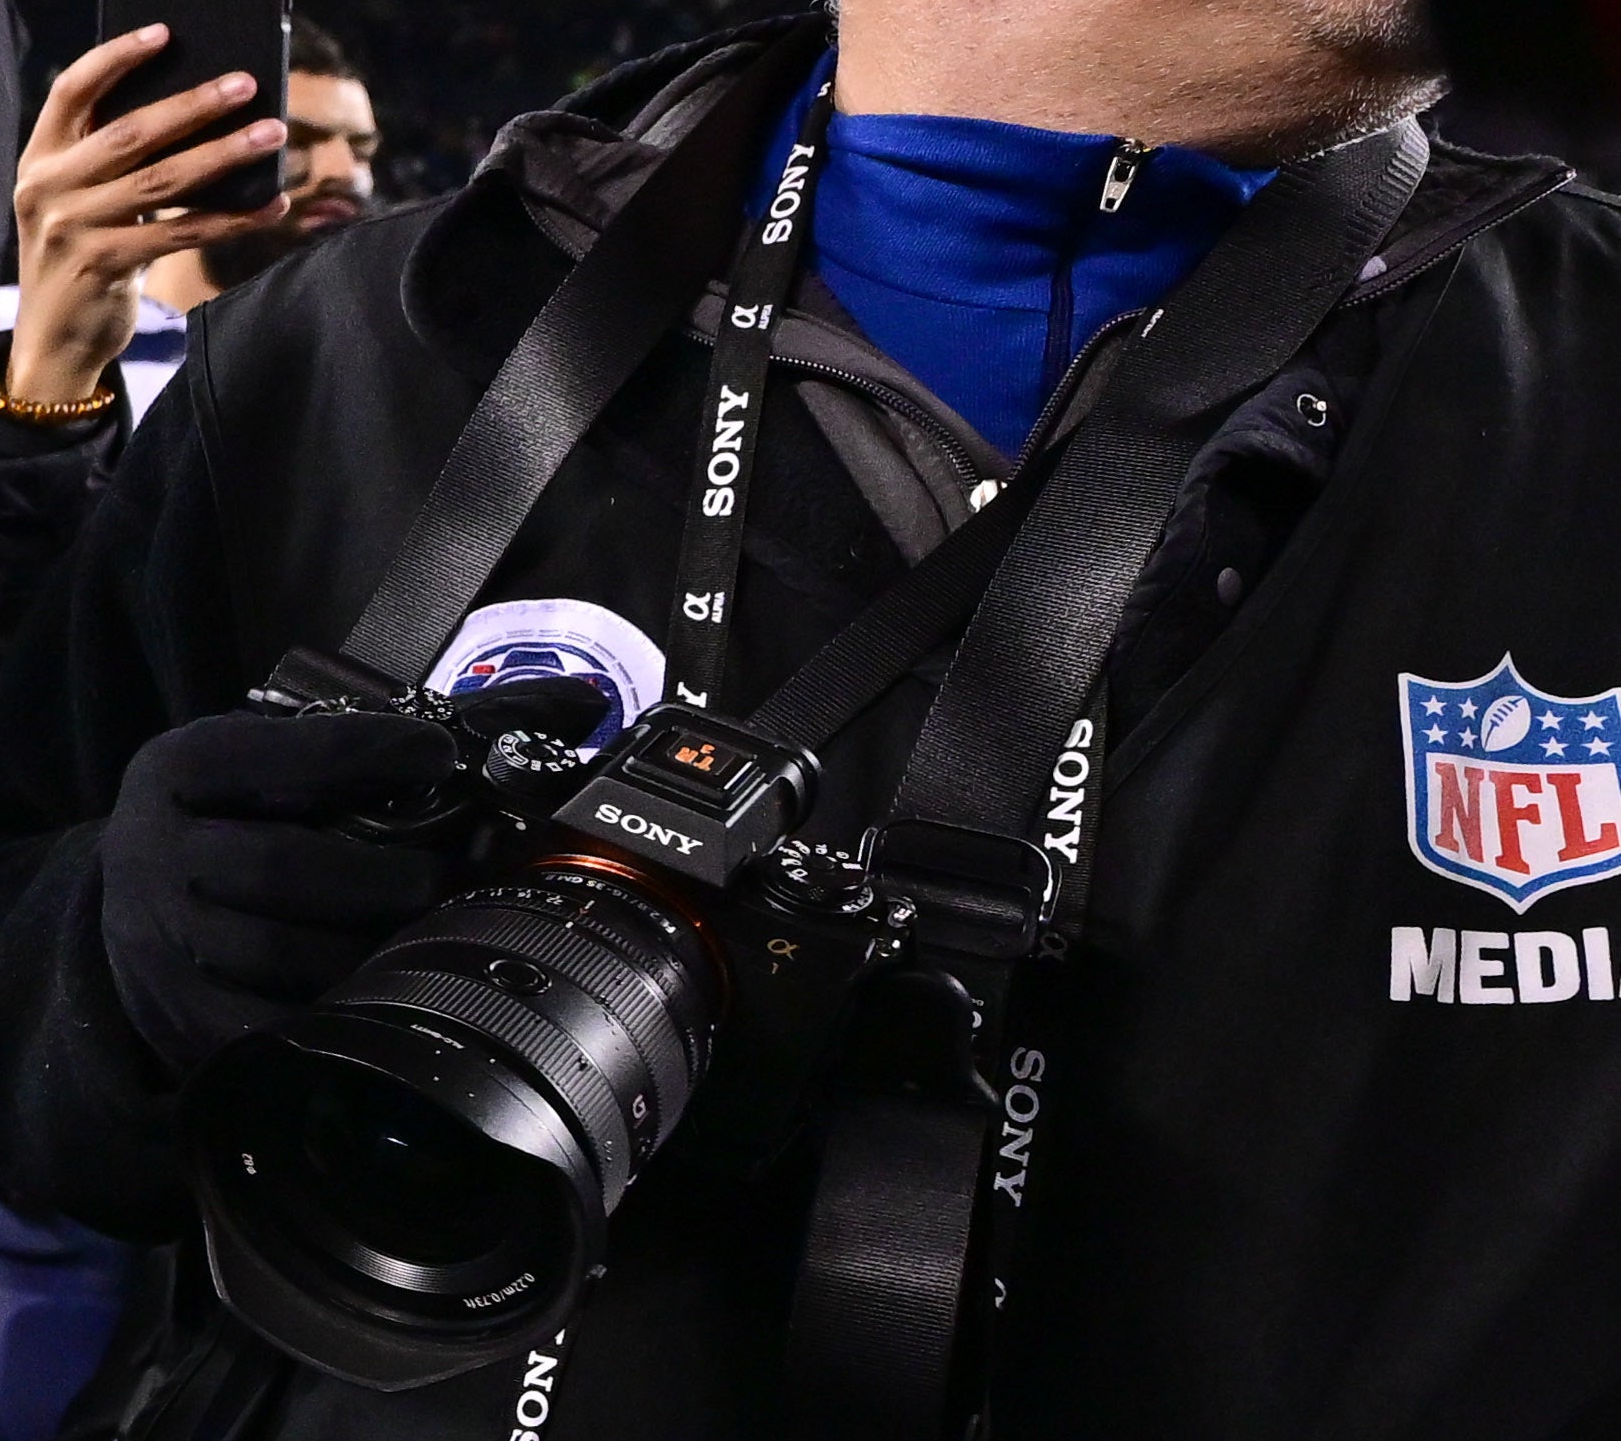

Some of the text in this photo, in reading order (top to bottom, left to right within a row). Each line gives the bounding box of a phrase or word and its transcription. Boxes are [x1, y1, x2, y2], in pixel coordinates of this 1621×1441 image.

[761, 143, 815, 245] SONY
[702, 384, 750, 518] SONY
[594, 803, 704, 855] SONY
[1044, 719, 1095, 864] SONY
[1434, 761, 1621, 875] NFL
[1389, 926, 1621, 1005] MEDI
[993, 1047, 1046, 1208] SONY
